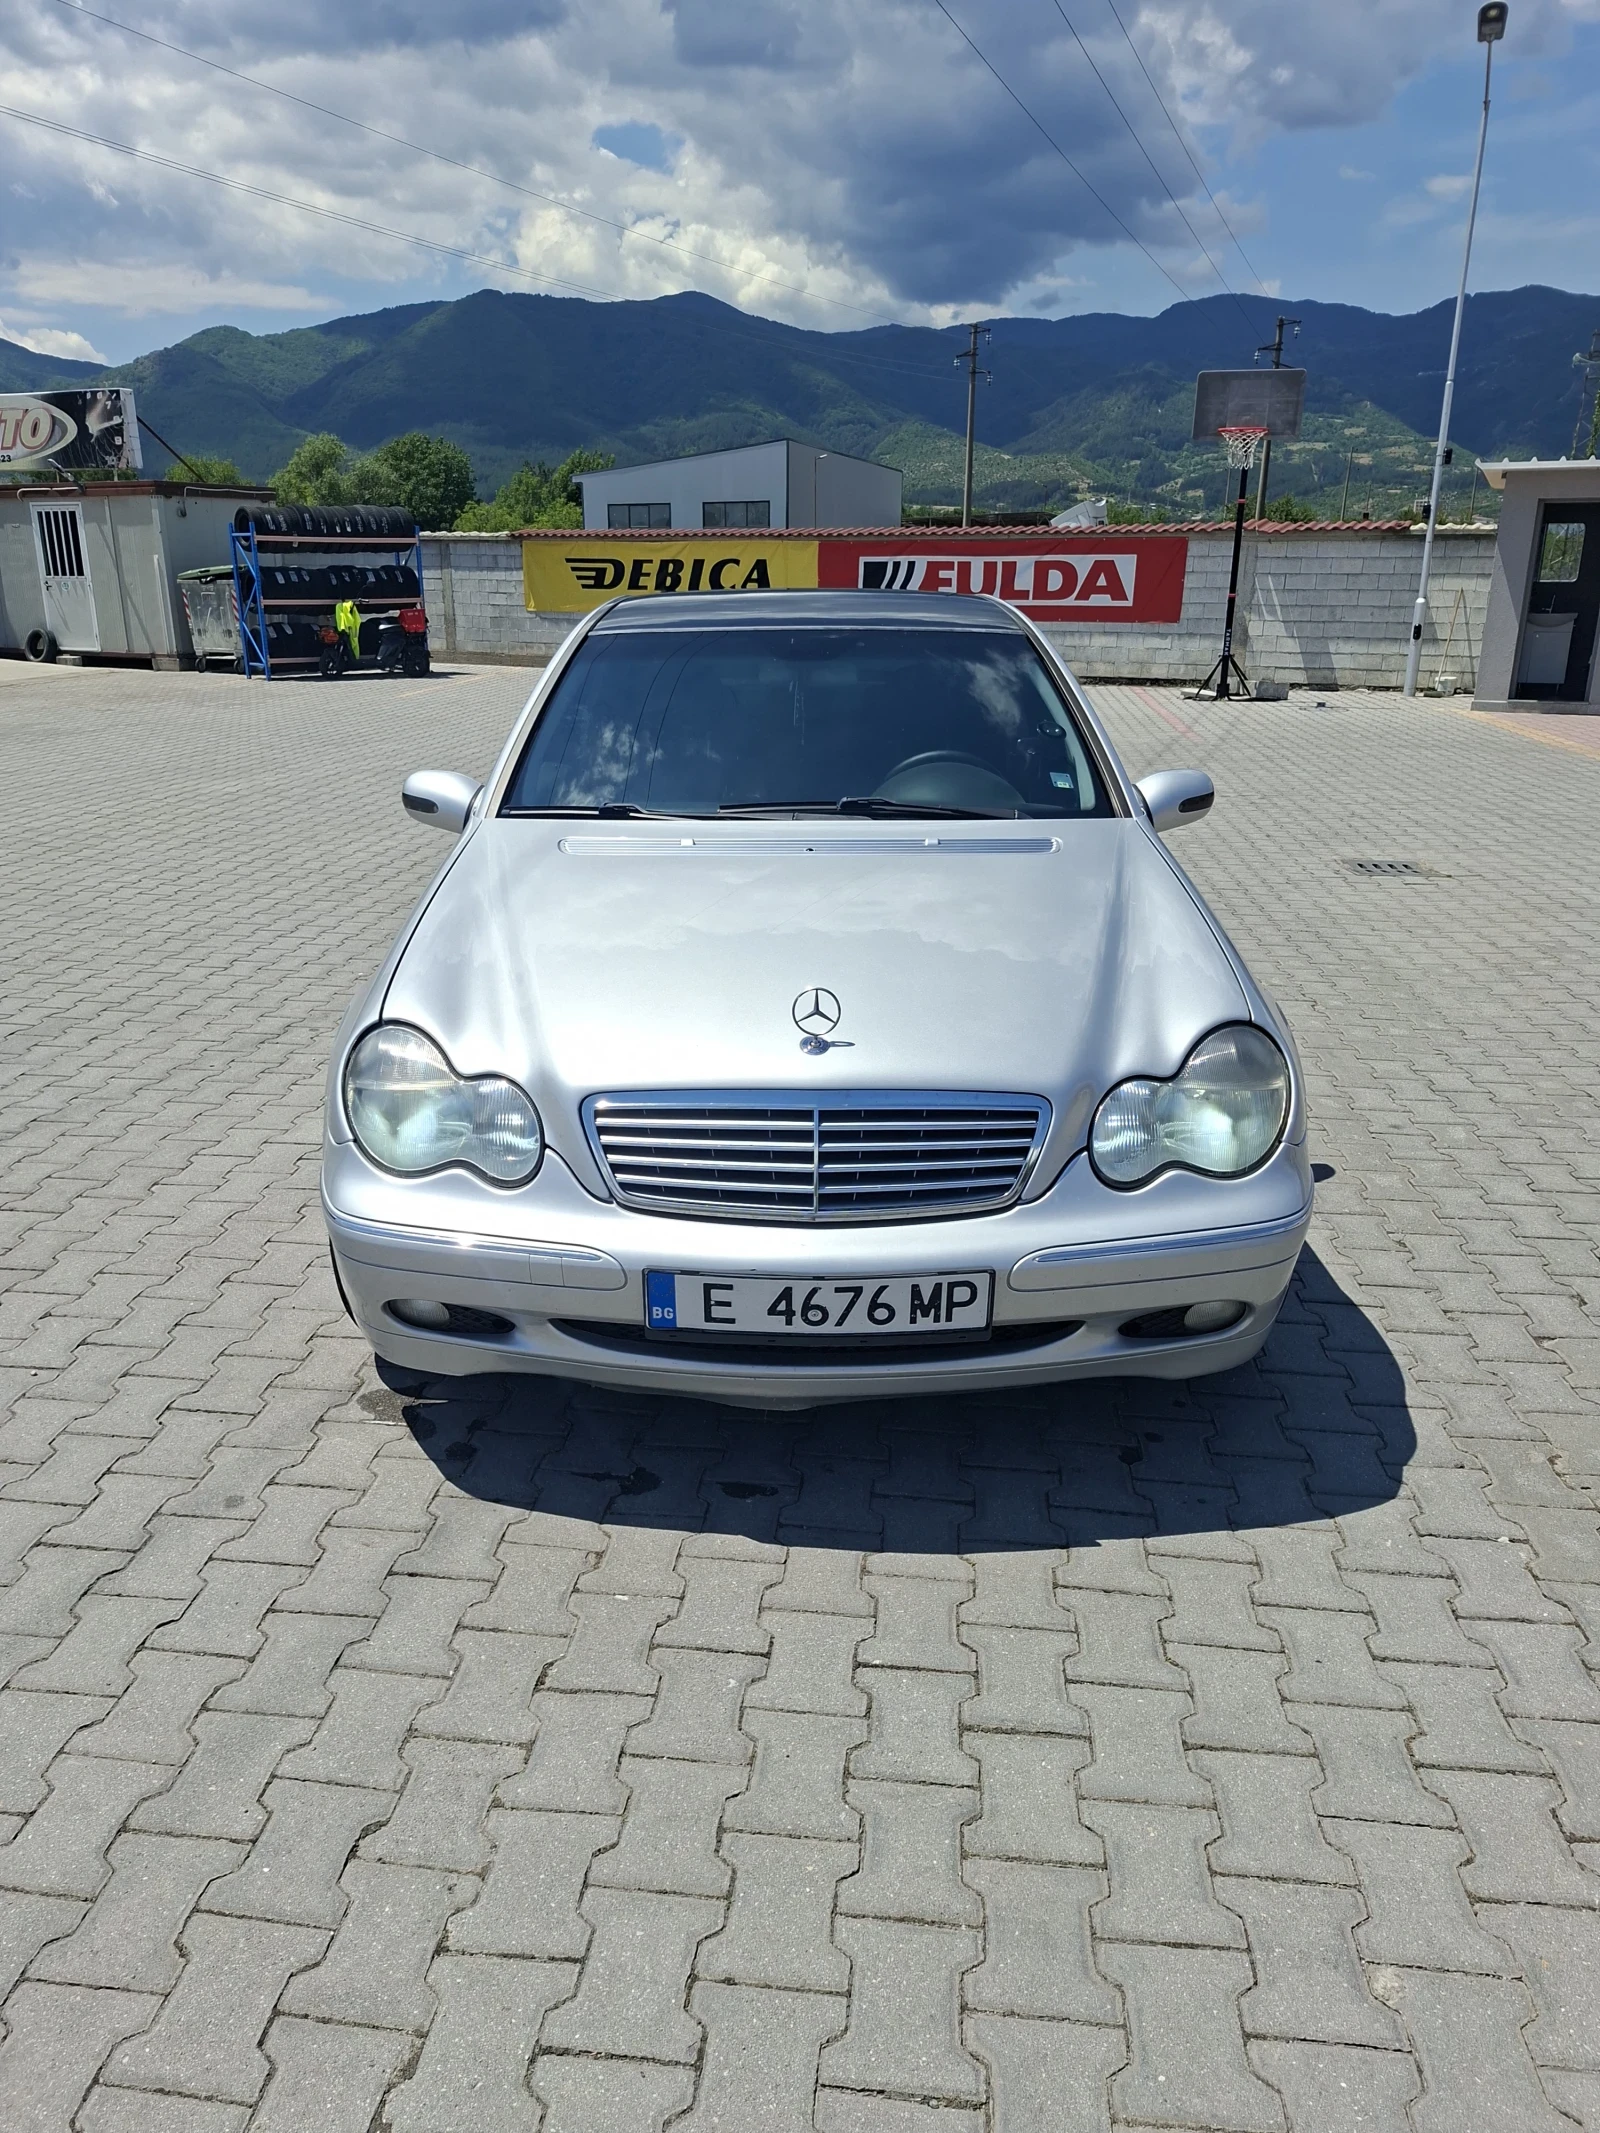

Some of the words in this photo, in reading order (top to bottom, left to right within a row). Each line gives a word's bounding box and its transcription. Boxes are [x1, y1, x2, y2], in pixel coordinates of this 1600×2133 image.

[0, 407, 52, 450] TO
[0, 454, 12, 463] 23
[917, 559, 1130, 602] FULDA
[652, 1306, 674, 1320] BG
[702, 1282, 736, 1325] E
[766, 1284, 896, 1327] 4676
[909, 1280, 978, 1325] MP
